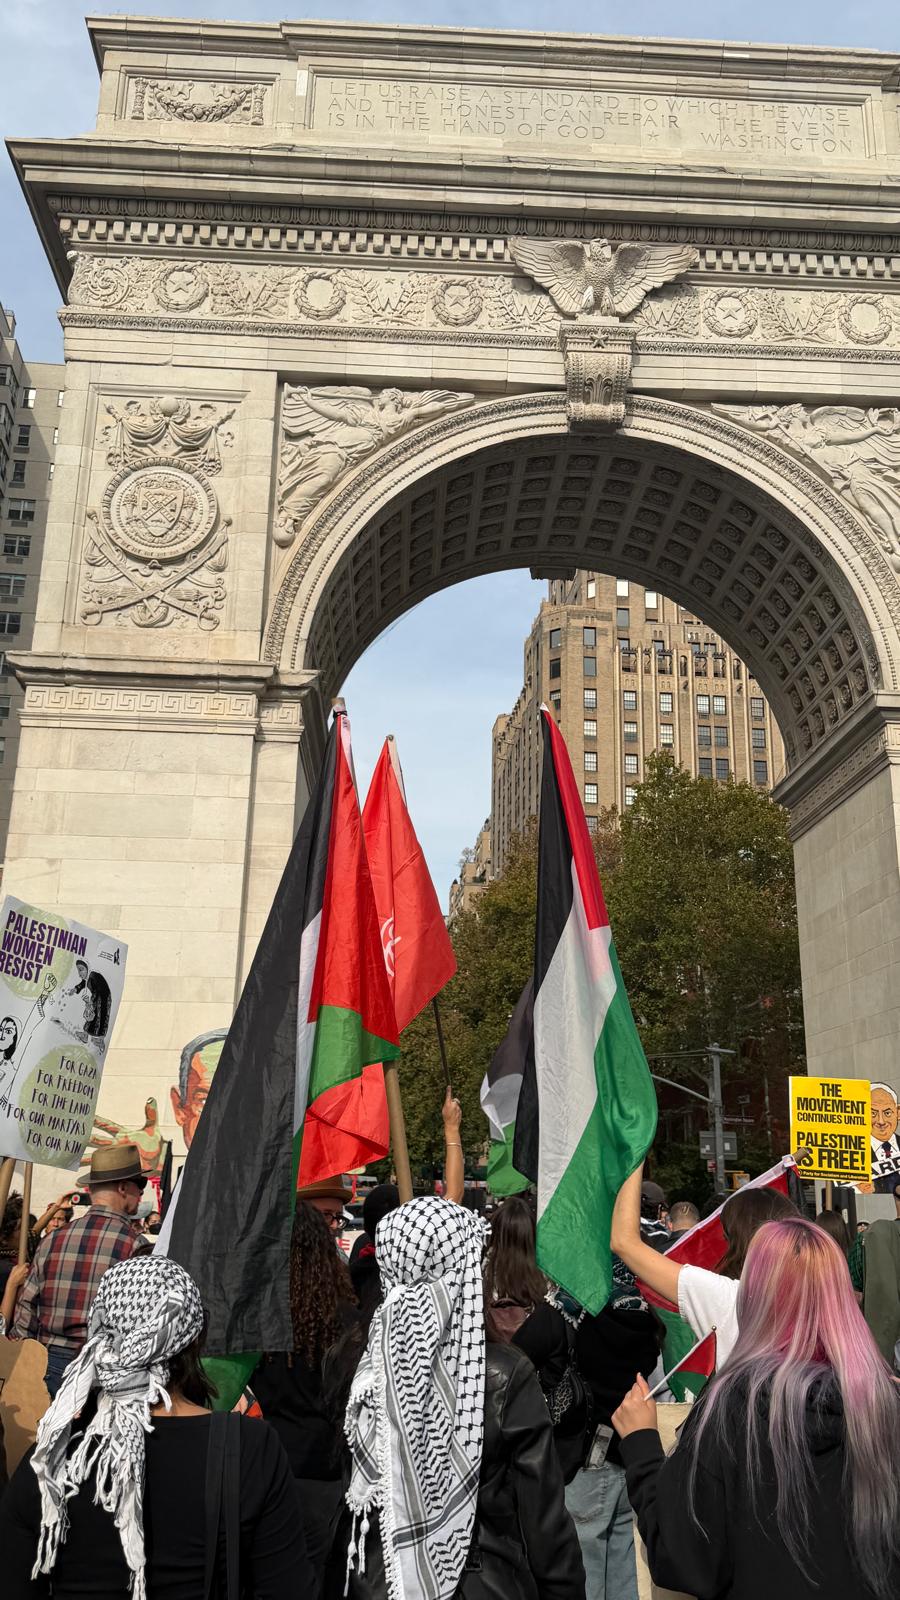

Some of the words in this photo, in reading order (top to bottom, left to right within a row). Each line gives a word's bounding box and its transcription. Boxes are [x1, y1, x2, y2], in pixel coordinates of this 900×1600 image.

[330, 82, 372, 96] LET
[378, 84, 402, 98] US
[409, 86, 471, 101] RAISE
[503, 90, 620, 109] STANDARD
[628, 97, 658, 111] TO
[666, 99, 738, 115] WHICH
[747, 104, 789, 119] THE
[797, 106, 849, 122] WISE
[328, 97, 372, 111] AND
[382, 100, 427, 115] THE
[440, 103, 532, 120] HONEST
[543, 108, 591, 123] CAN
[603, 111, 680, 128] REPAIR
[717, 117, 762, 132] THE
[776, 120, 850, 137] EVENT
[328, 113, 345, 127] IS
[355, 114, 375, 128] IN
[385, 115, 431, 131] THE
[443, 118, 506, 134] HAND
[518, 123, 548, 136] OF
[557, 125, 605, 140] GOD
[700, 132, 852, 152] WASHINGTON
[5, 909, 88, 957] PALESTINIAN
[1, 930, 55, 966] WOMEN
[0, 950, 43, 984] RESIST
[59, 1055, 75, 1074] FOR
[78, 1062, 97, 1080] GAZA
[36, 1069, 53, 1087] FOR
[56, 1074, 94, 1100] FREEDOM
[819, 1083, 842, 1098] THE
[31, 1088, 48, 1107] FOR
[51, 1093, 68, 1110] THE
[68, 1099, 91, 1115] LAND
[796, 1097, 867, 1115] MOVEMENT
[6, 1103, 26, 1122] FOR
[29, 1111, 45, 1127] OUR
[47, 1115, 86, 1136] MARTYRS
[797, 1112, 842, 1124] CONTINUES
[844, 1115, 867, 1126] UNTIL
[26, 1129, 42, 1148] FOR
[45, 1135, 61, 1151] OUR
[64, 1139, 82, 1154] KIN
[796, 1131, 866, 1151] PALESTINE
[817, 1148, 866, 1171] FREE!
